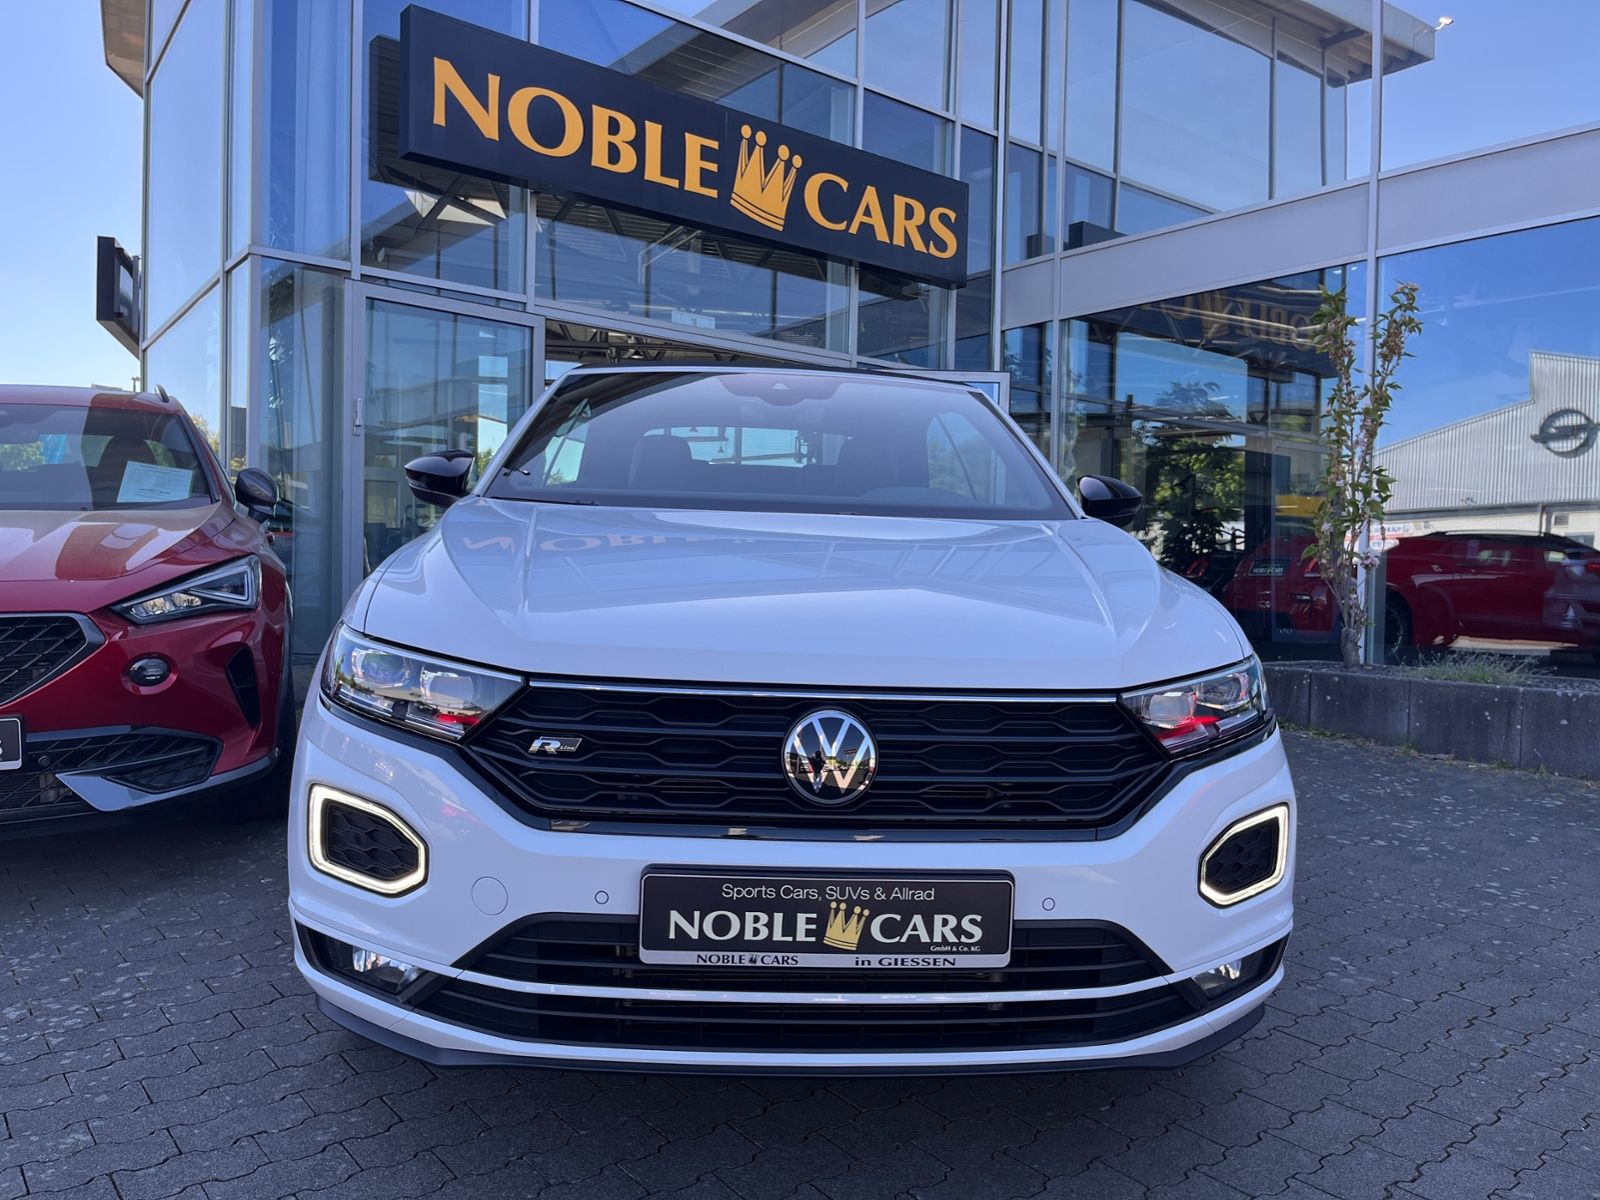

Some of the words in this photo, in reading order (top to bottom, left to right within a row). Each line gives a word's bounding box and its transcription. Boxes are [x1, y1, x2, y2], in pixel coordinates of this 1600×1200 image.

[433, 56, 720, 199] NOBLE
[803, 172, 958, 259] CARS
[721, 884, 776, 900] Sports
[780, 885, 822, 900] Cars,
[825, 886, 870, 900] SUVs
[874, 887, 886, 900] &
[890, 887, 935, 900] Allrad
[668, 910, 818, 942] NOBLE
[870, 913, 983, 943] CARS
[696, 953, 746, 965] NOBLE
[760, 954, 799, 965] CARS
[855, 957, 871, 966] in
[878, 957, 956, 967] GIESSEN
